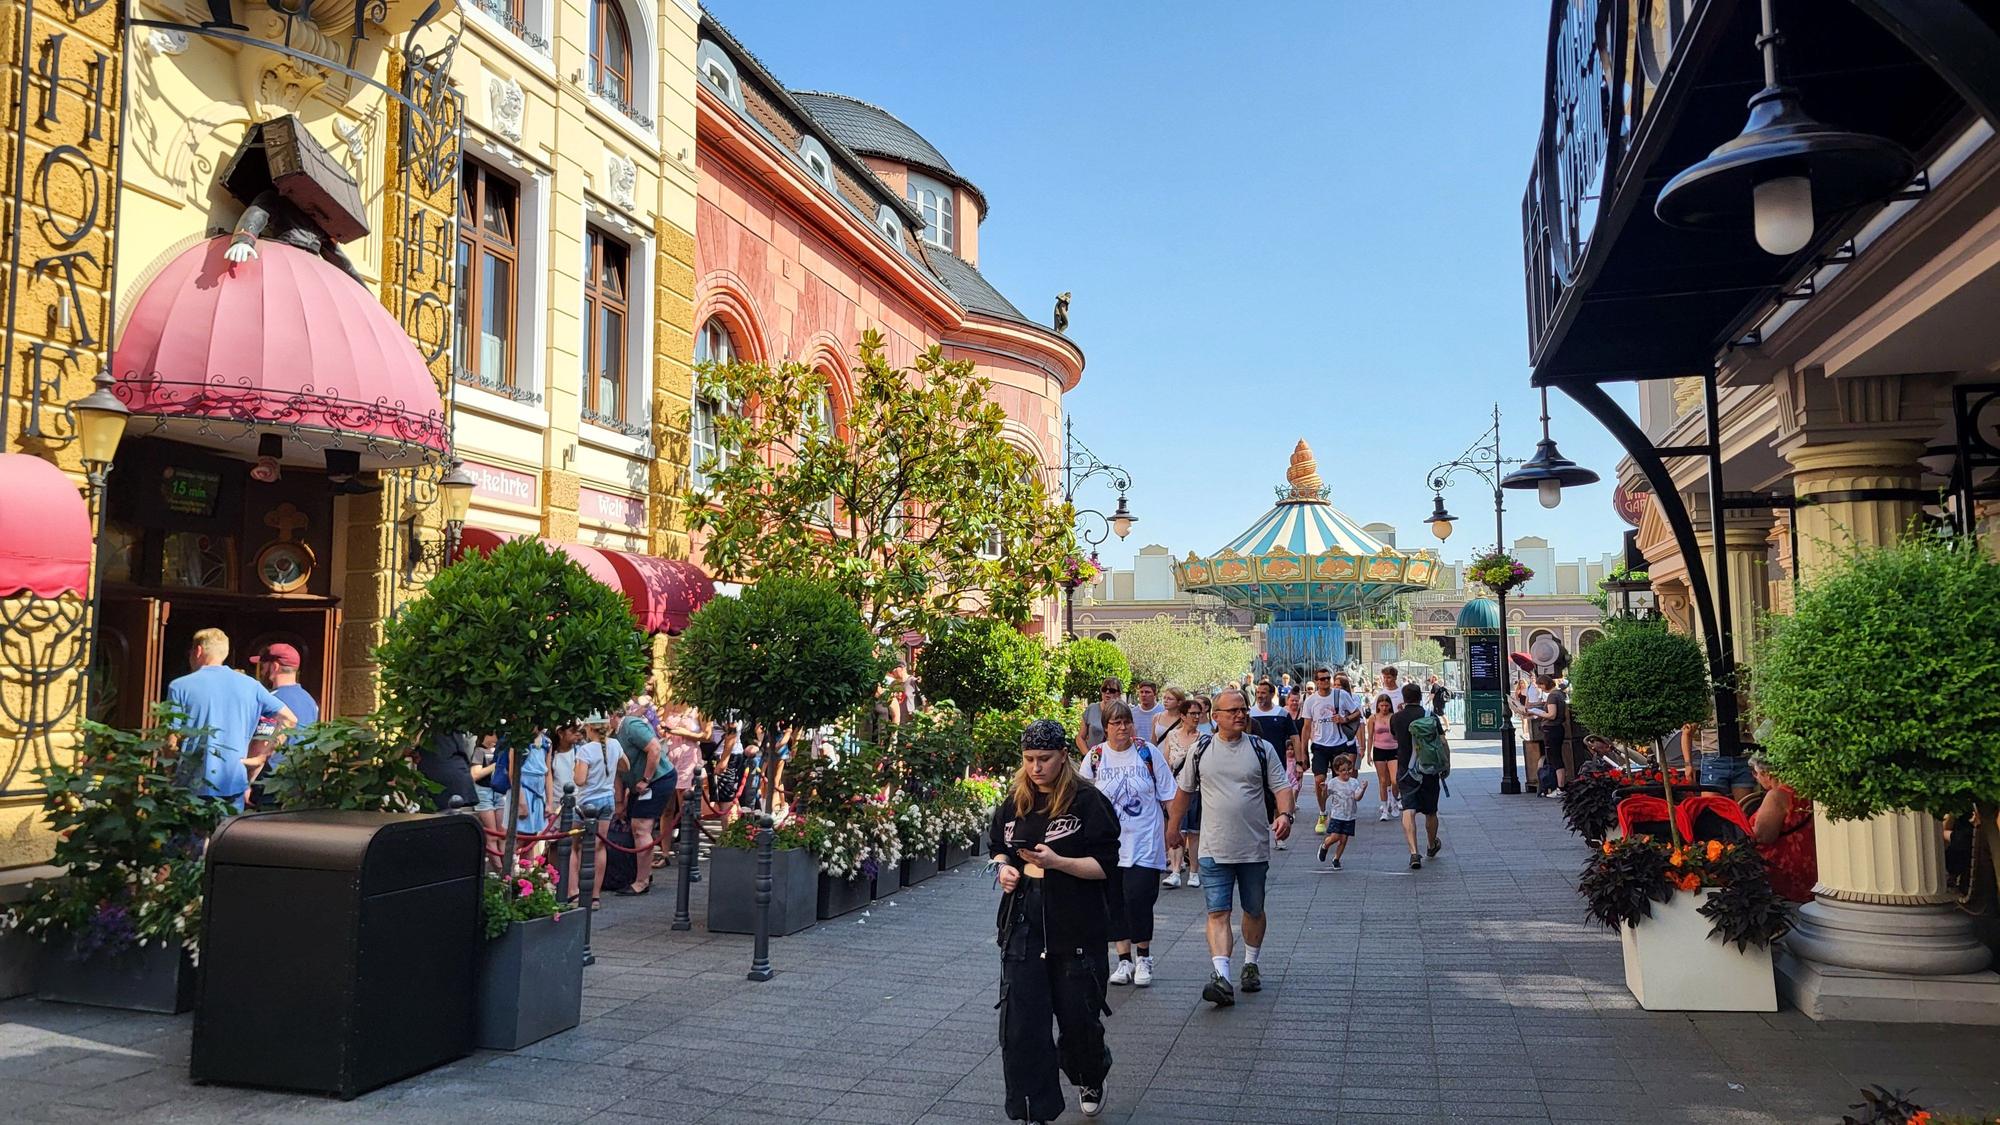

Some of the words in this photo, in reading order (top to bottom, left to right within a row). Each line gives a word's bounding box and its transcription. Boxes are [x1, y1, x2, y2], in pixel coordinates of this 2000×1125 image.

[24, 33, 110, 442] HOTE
[172, 480, 187, 495] 15
[464, 468, 529, 499] er-kehrte
[597, 495, 623, 518] Welt
